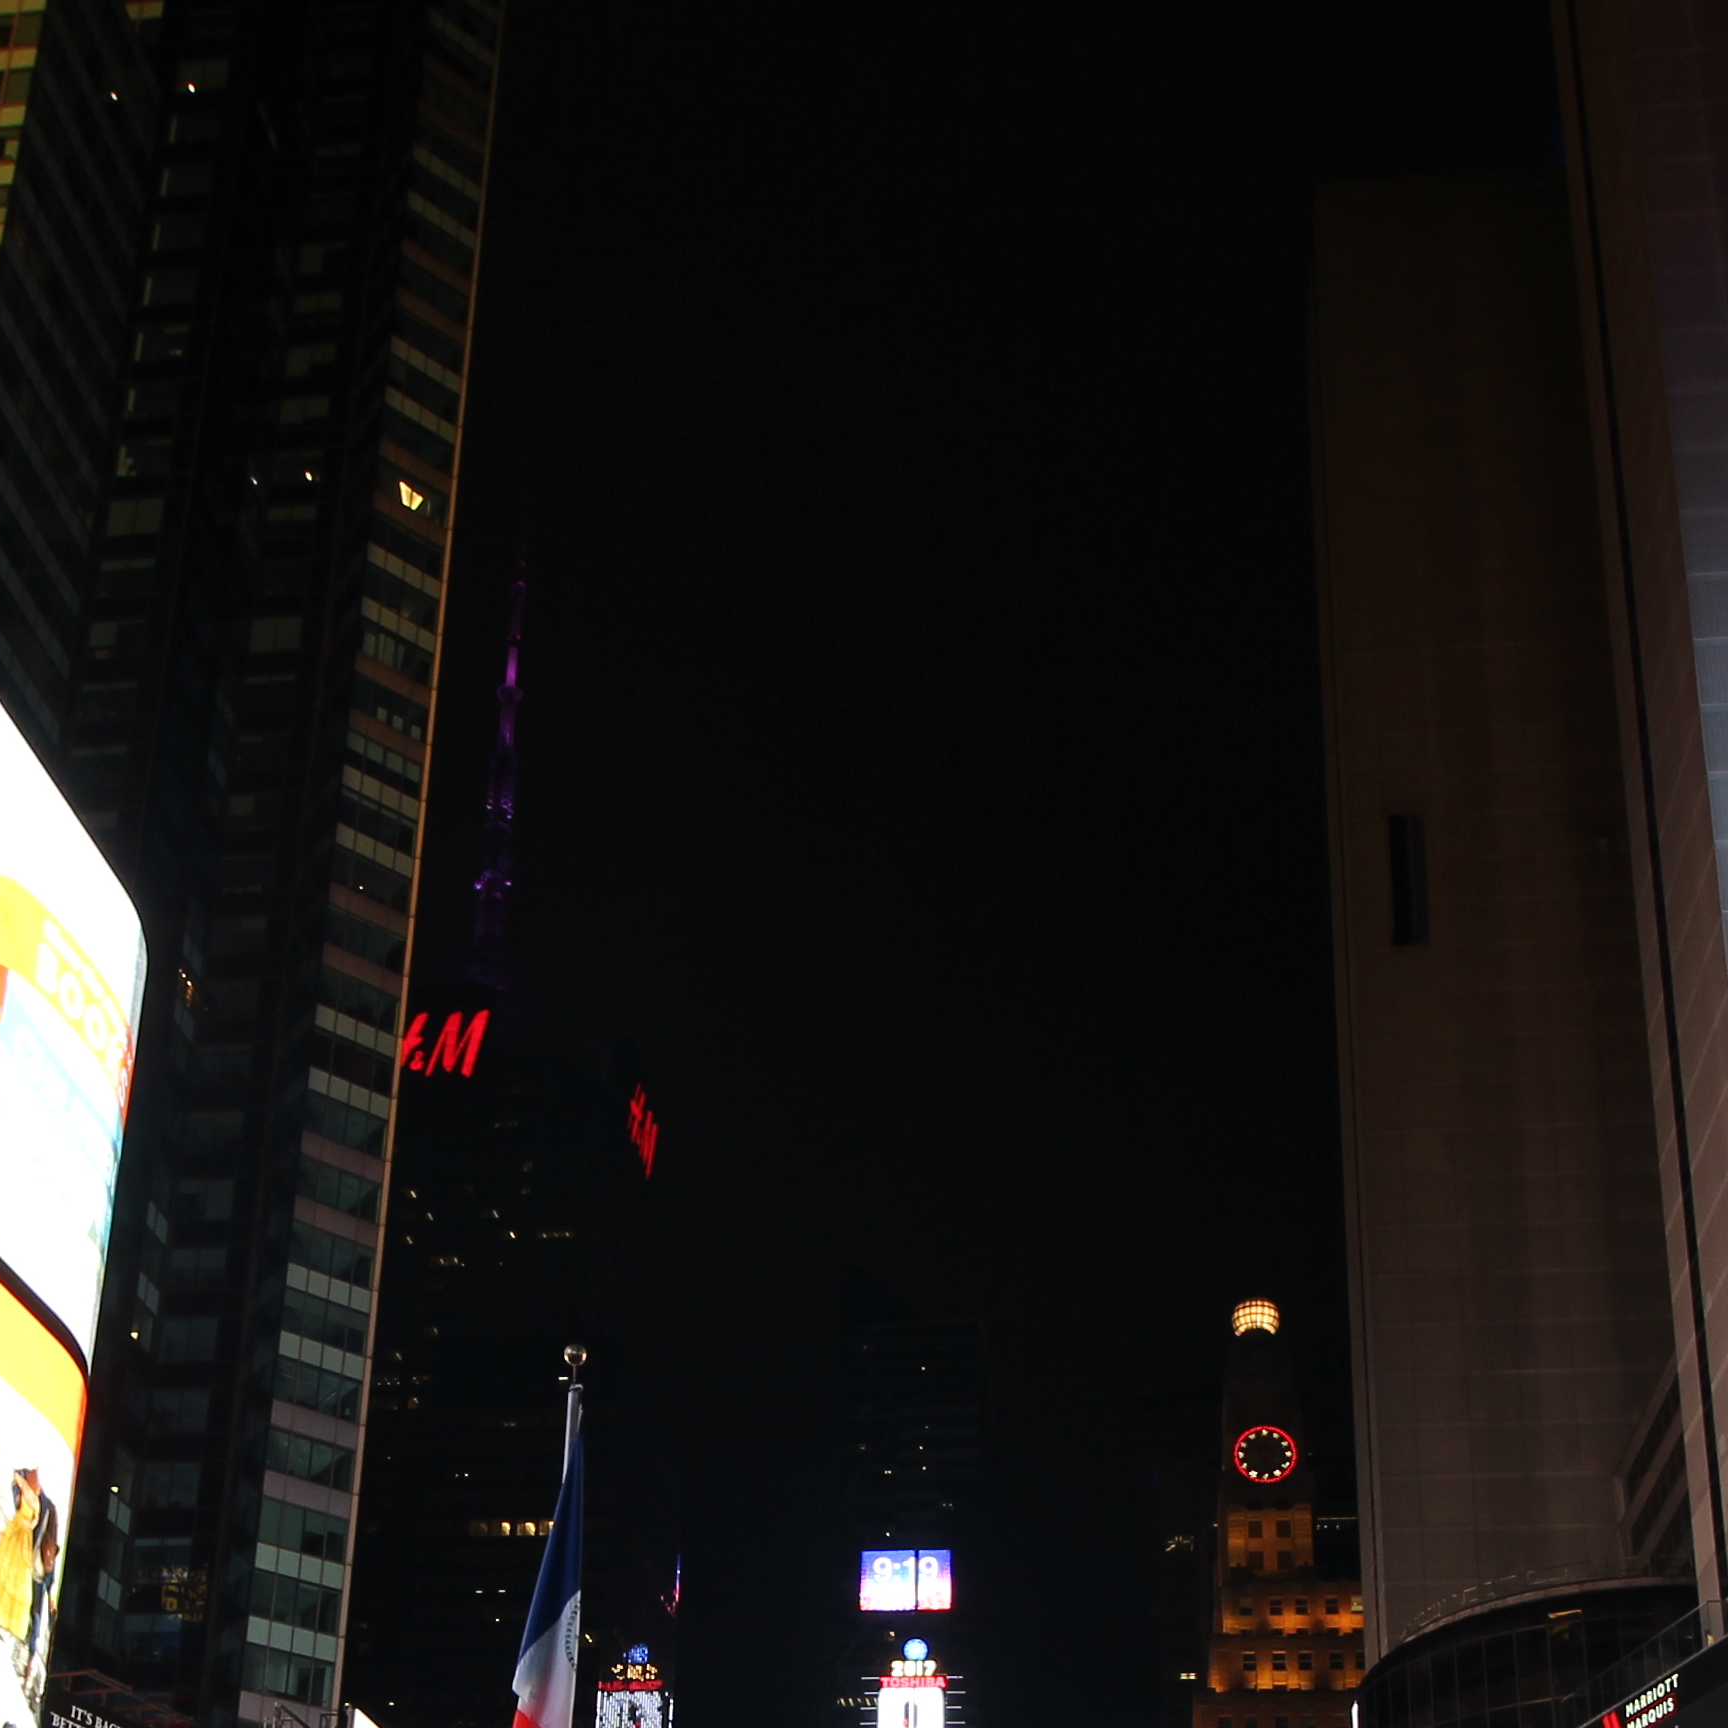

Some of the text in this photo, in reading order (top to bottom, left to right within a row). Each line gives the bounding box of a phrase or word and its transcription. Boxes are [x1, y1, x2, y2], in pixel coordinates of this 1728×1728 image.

[873, 1556, 939, 1584] 9:19
[890, 1660, 937, 1677] 2017
[879, 1676, 948, 1689] TOSHIBA
[1625, 1673, 1680, 1718] MARRIOTT
[70, 1704, 93, 1726] IT'S
